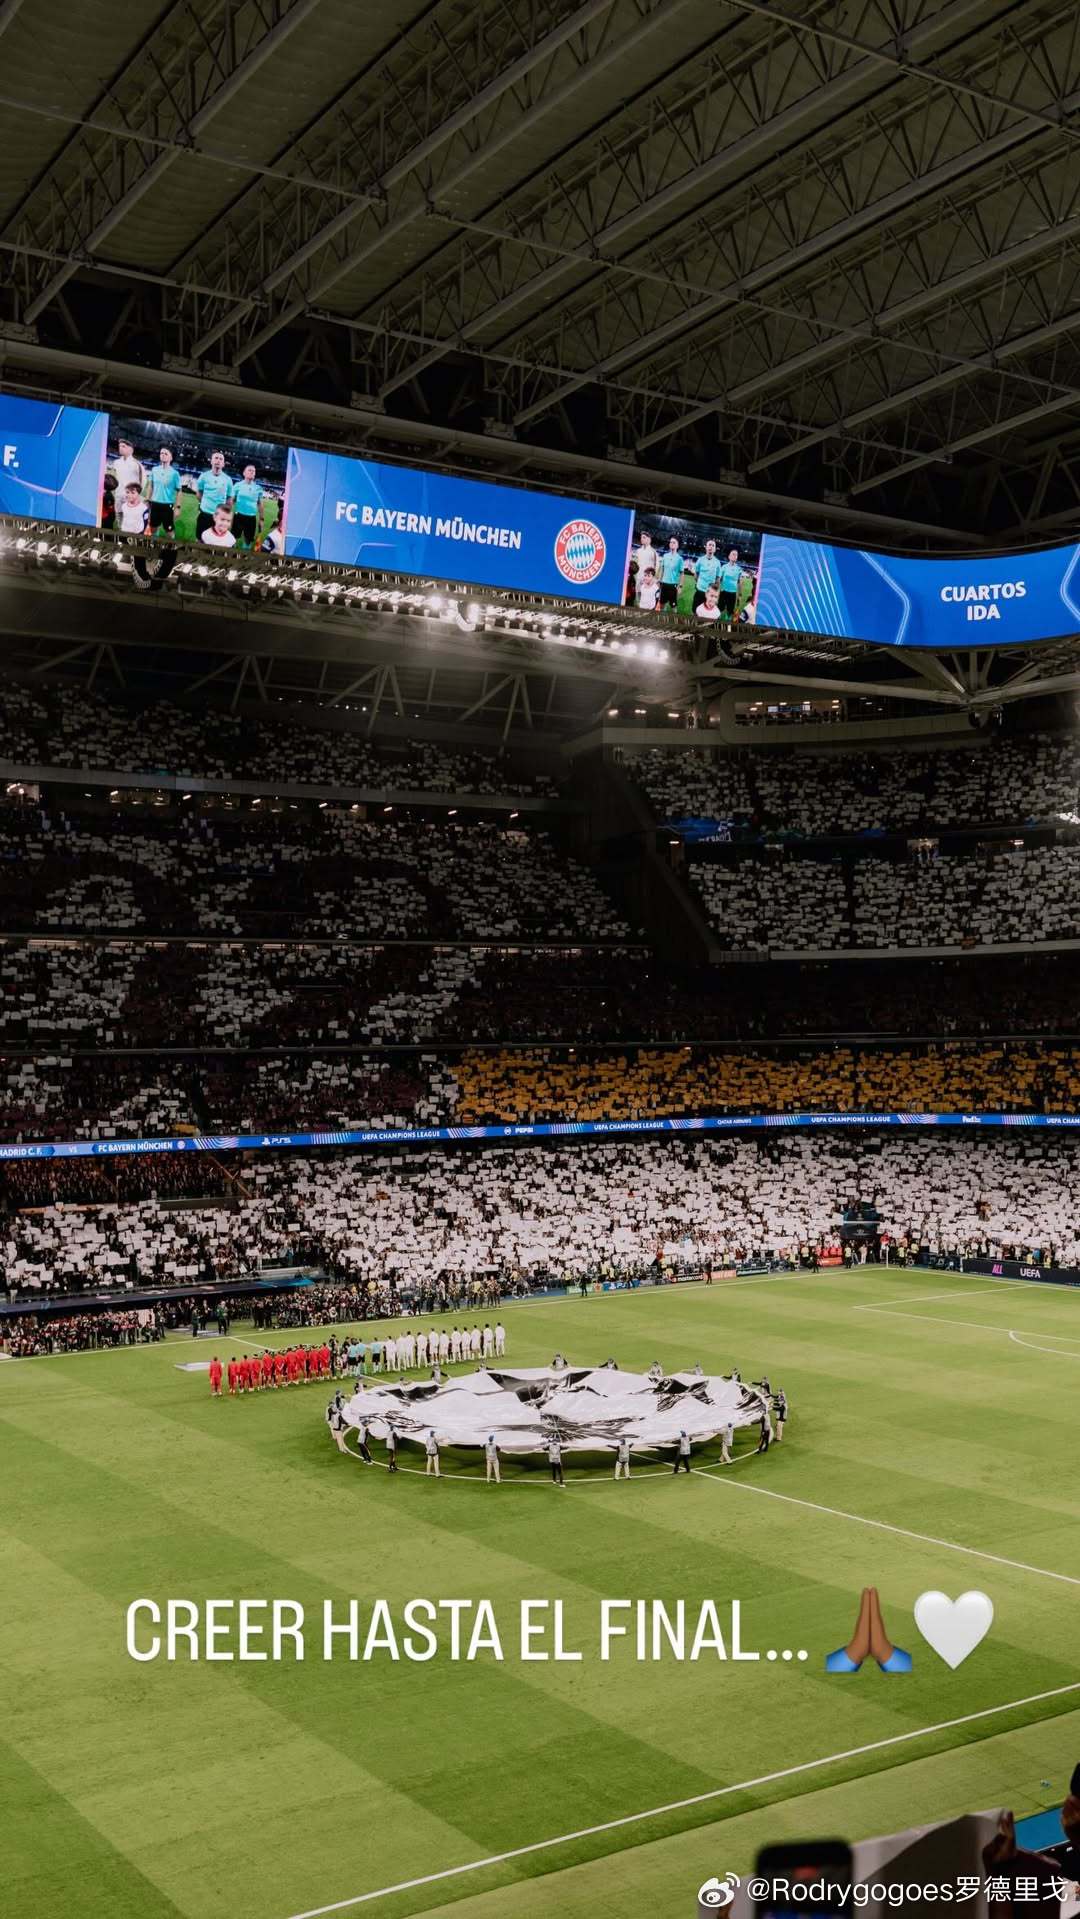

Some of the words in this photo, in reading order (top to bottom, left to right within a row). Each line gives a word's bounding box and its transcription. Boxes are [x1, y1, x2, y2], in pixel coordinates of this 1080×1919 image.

[3, 444, 20, 468] F.
[335, 501, 358, 524] FC
[361, 504, 432, 536] BAYERN
[435, 515, 522, 549] MÜNCHEN
[559, 530, 571, 544] FC
[571, 523, 603, 549] BAYERN
[941, 581, 1027, 602] CUARTOS
[967, 604, 1001, 621] IDA
[108, 1143, 135, 1151] BAYERN
[137, 1141, 173, 1150] MÜNCHEN
[1020, 1267, 1041, 1278] UEFA
